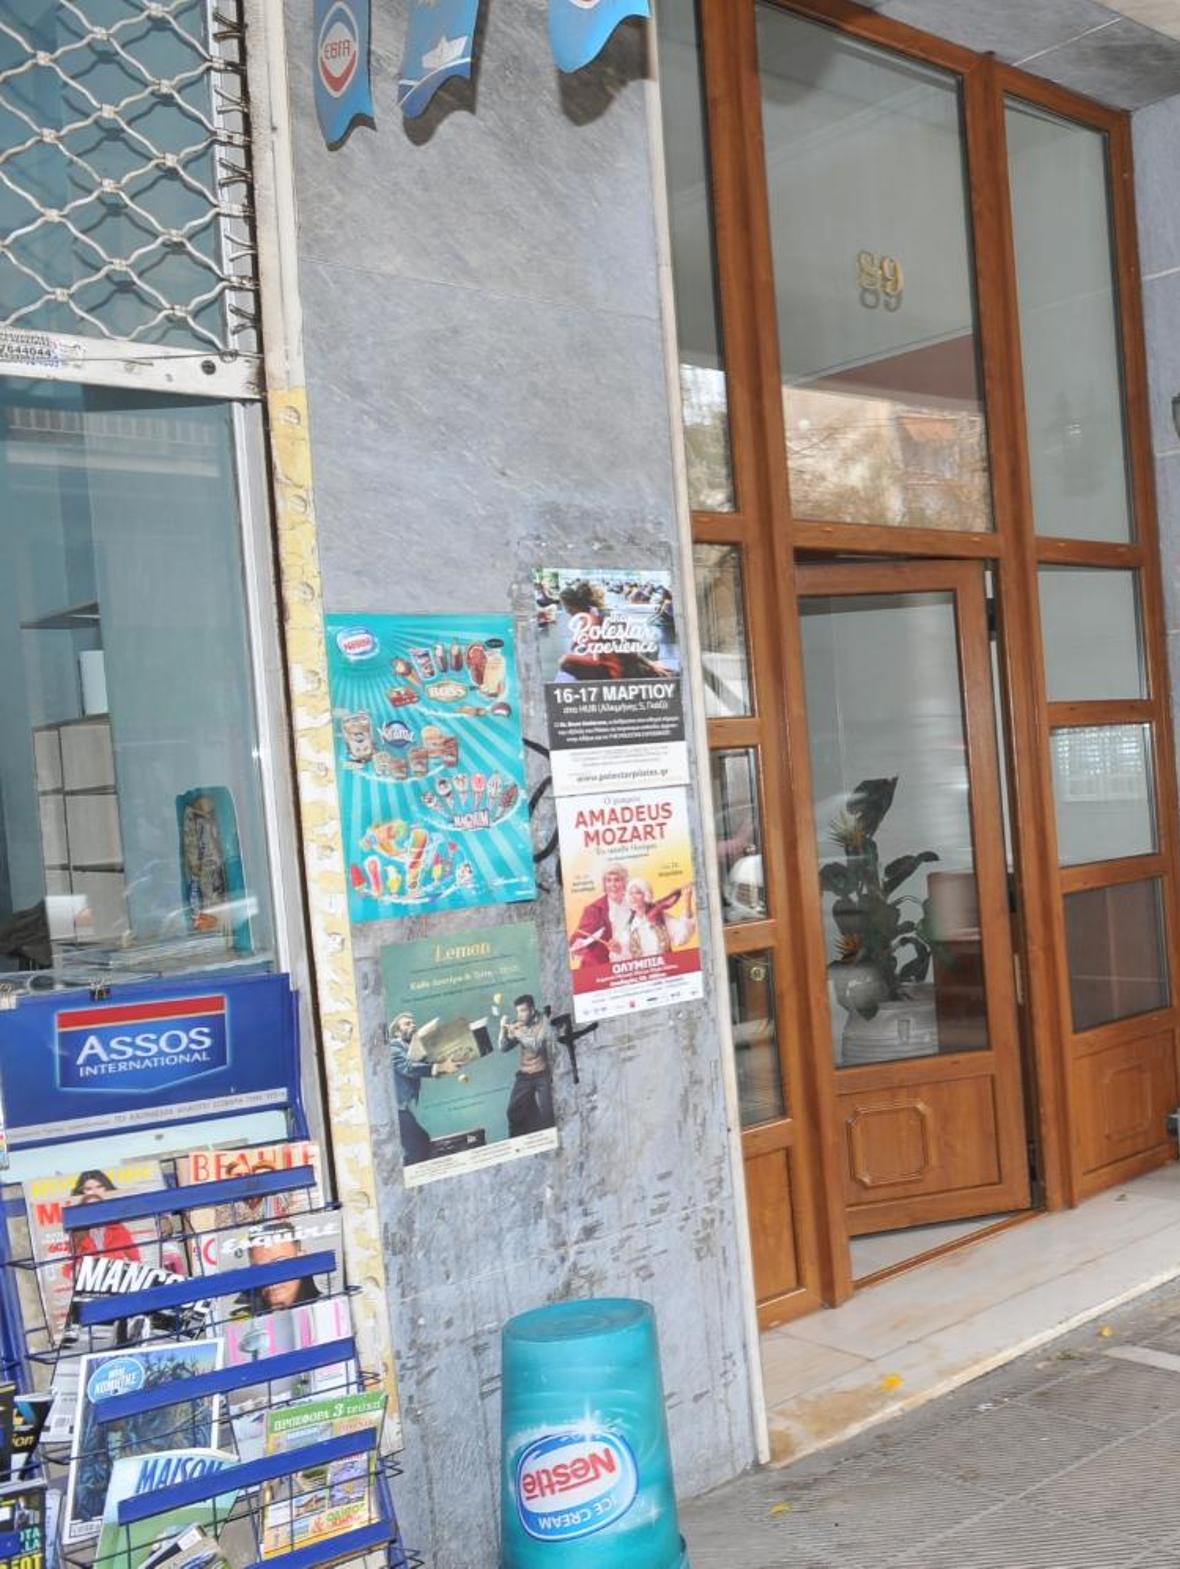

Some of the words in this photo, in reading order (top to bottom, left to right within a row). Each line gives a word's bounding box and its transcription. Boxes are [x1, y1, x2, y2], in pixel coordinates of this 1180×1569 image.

[569, 612, 659, 643] Polestar
[575, 636, 658, 662] Experience
[553, 686, 599, 704] 16-17
[602, 682, 677, 702] ΜΑΡΤΙΟΥ
[575, 802, 673, 829] AMADEUS
[583, 822, 668, 848] MOZART
[435, 941, 492, 962] Lemon
[76, 1025, 213, 1066] ASSOS
[79, 1051, 212, 1079] INTERNATIONAL
[135, 1456, 225, 1494] MAISON
[540, 1510, 591, 1530] CREAM
[589, 1495, 615, 1519] ICE
